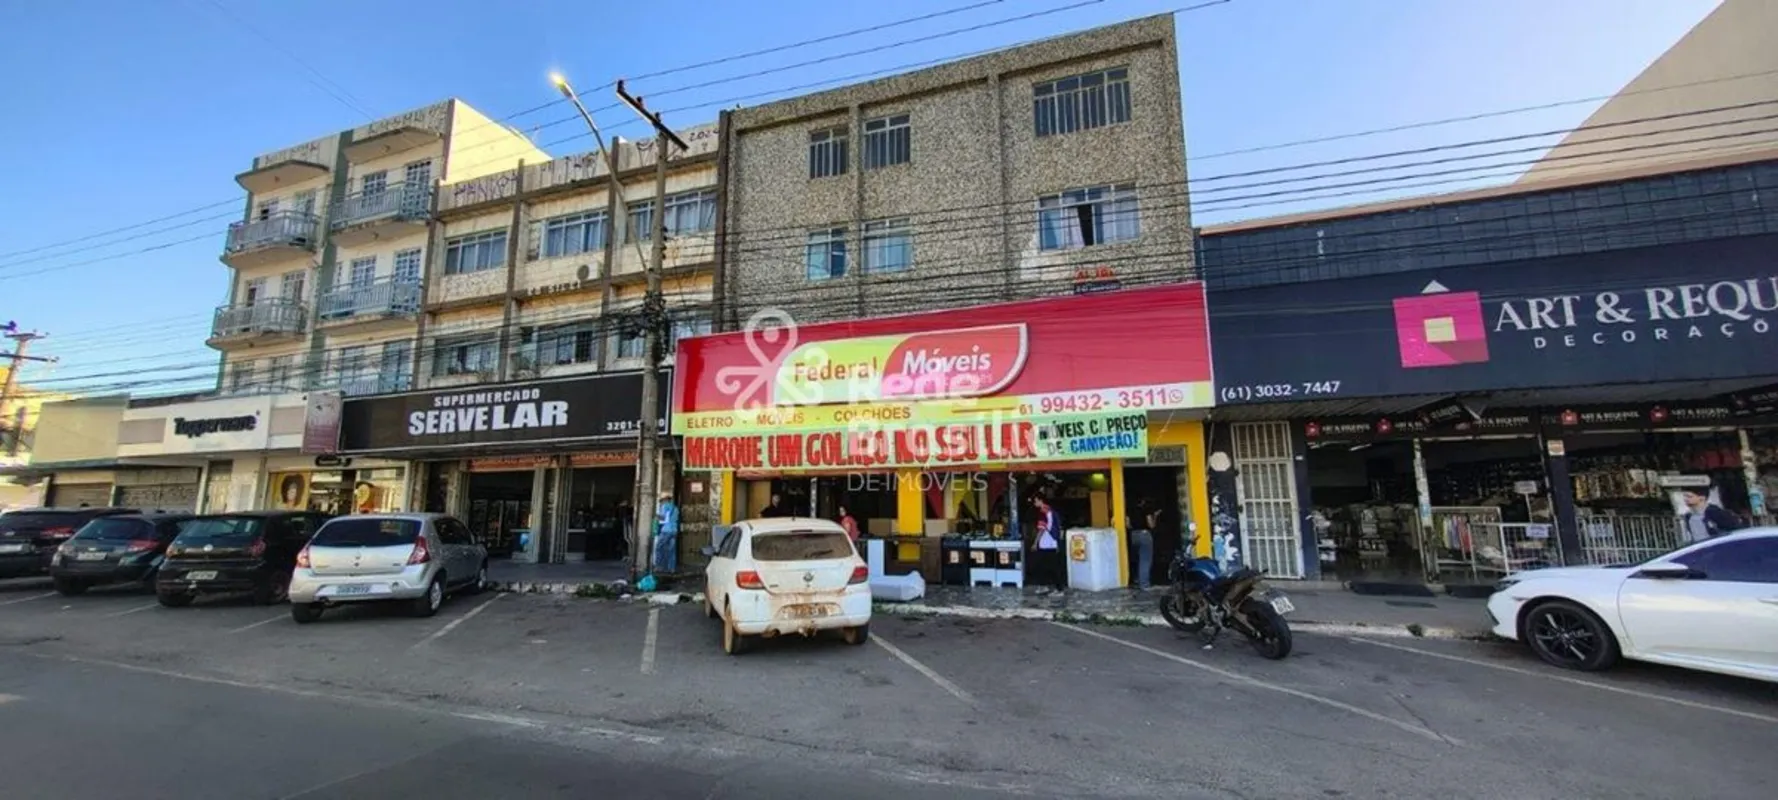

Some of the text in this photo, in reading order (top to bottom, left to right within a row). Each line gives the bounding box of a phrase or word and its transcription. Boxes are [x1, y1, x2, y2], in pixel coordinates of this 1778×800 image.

[1494, 295, 1580, 332] ART
[1595, 291, 1635, 323] &
[1533, 317, 1768, 349] DECORAÇÕ
[795, 356, 877, 382] Federal
[902, 344, 991, 374] Móveis
[434, 388, 540, 407] SUPERMERCADO
[1118, 389, 1167, 409] 3511
[1221, 381, 1340, 402] (61) 3032- 7447
[174, 415, 257, 438] Tupperware
[606, 419, 665, 431] 3201-0
[687, 416, 733, 428] ELETRO
[685, 435, 763, 470] MARQUE
[768, 433, 802, 467] UM
[894, 428, 929, 464] NO
[1047, 441, 1065, 455] DE
